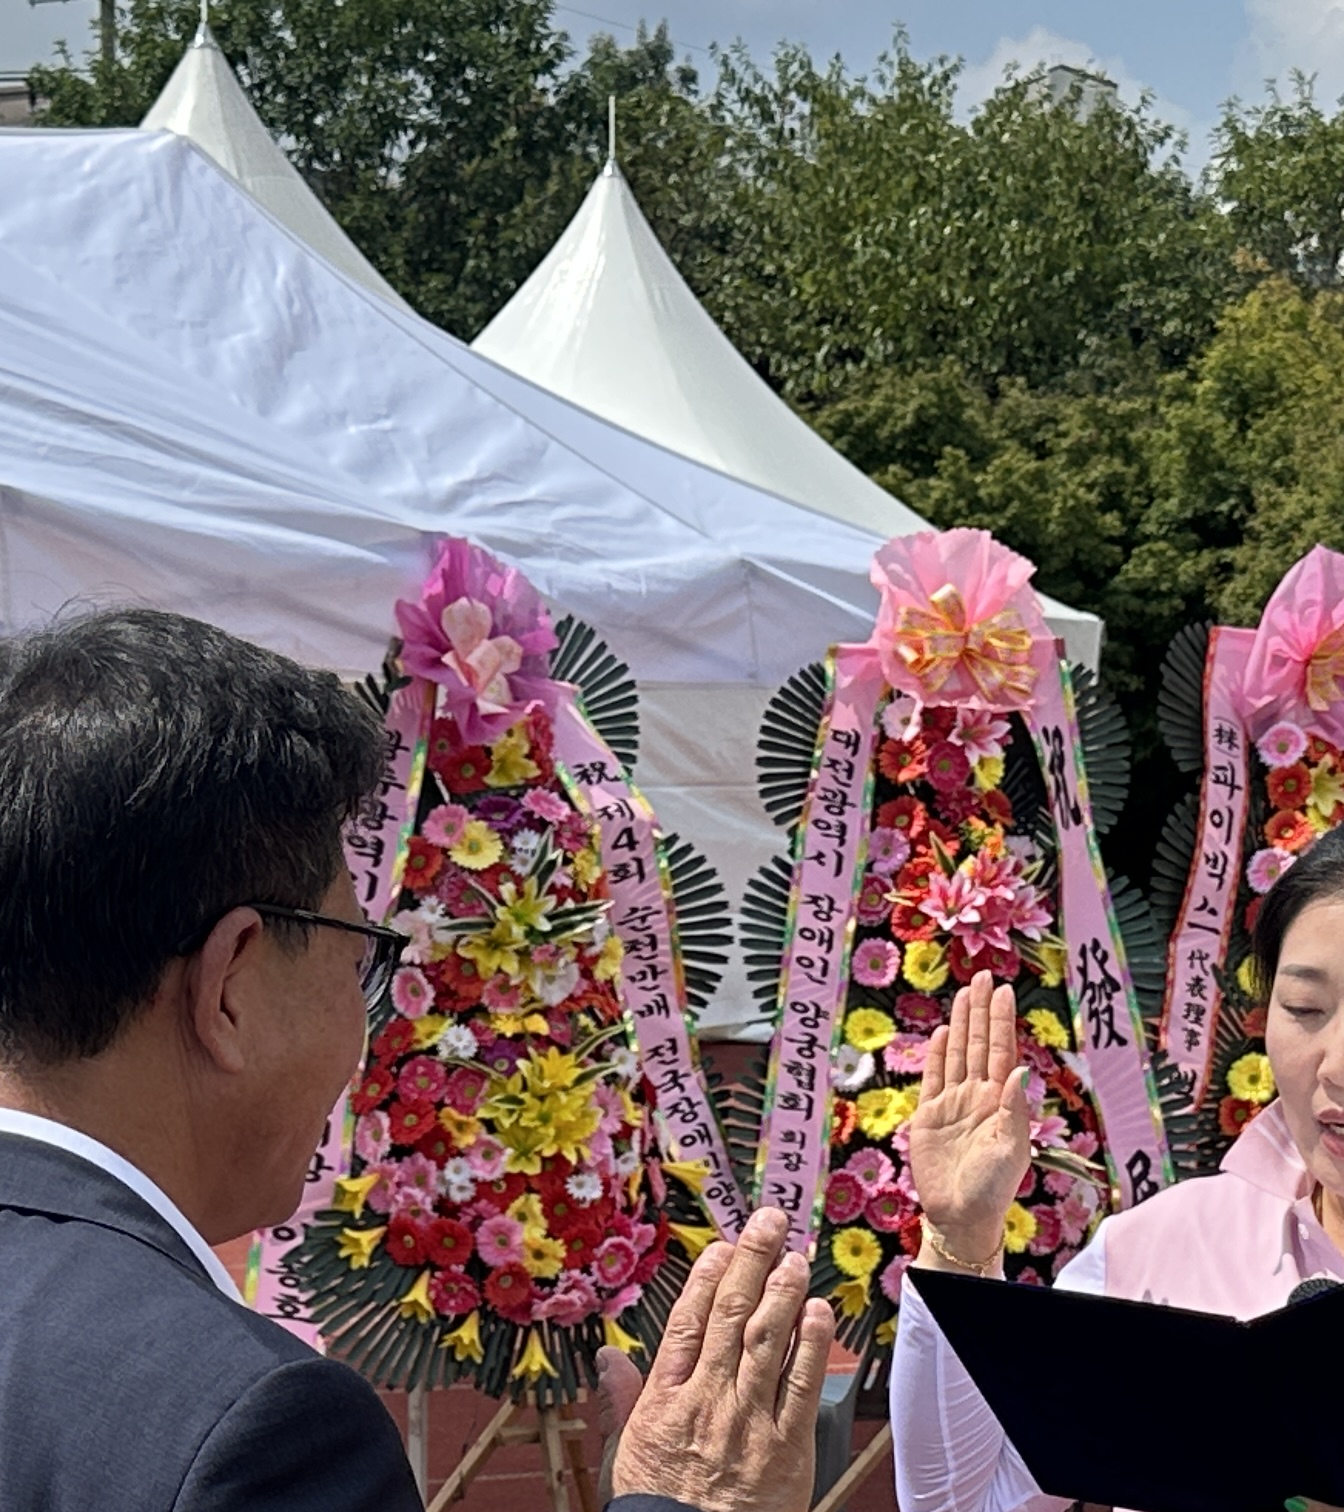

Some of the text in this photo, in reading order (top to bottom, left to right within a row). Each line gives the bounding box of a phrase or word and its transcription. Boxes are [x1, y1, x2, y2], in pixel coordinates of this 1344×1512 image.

[597, 799, 646, 884] 제4회
[804, 728, 860, 878] 대전광역시
[795, 893, 843, 985] 장애인
[1186, 949, 1210, 1052] 代表理事
[777, 1000, 830, 1122] 양궁협회
[775, 1129, 807, 1172] 회장
